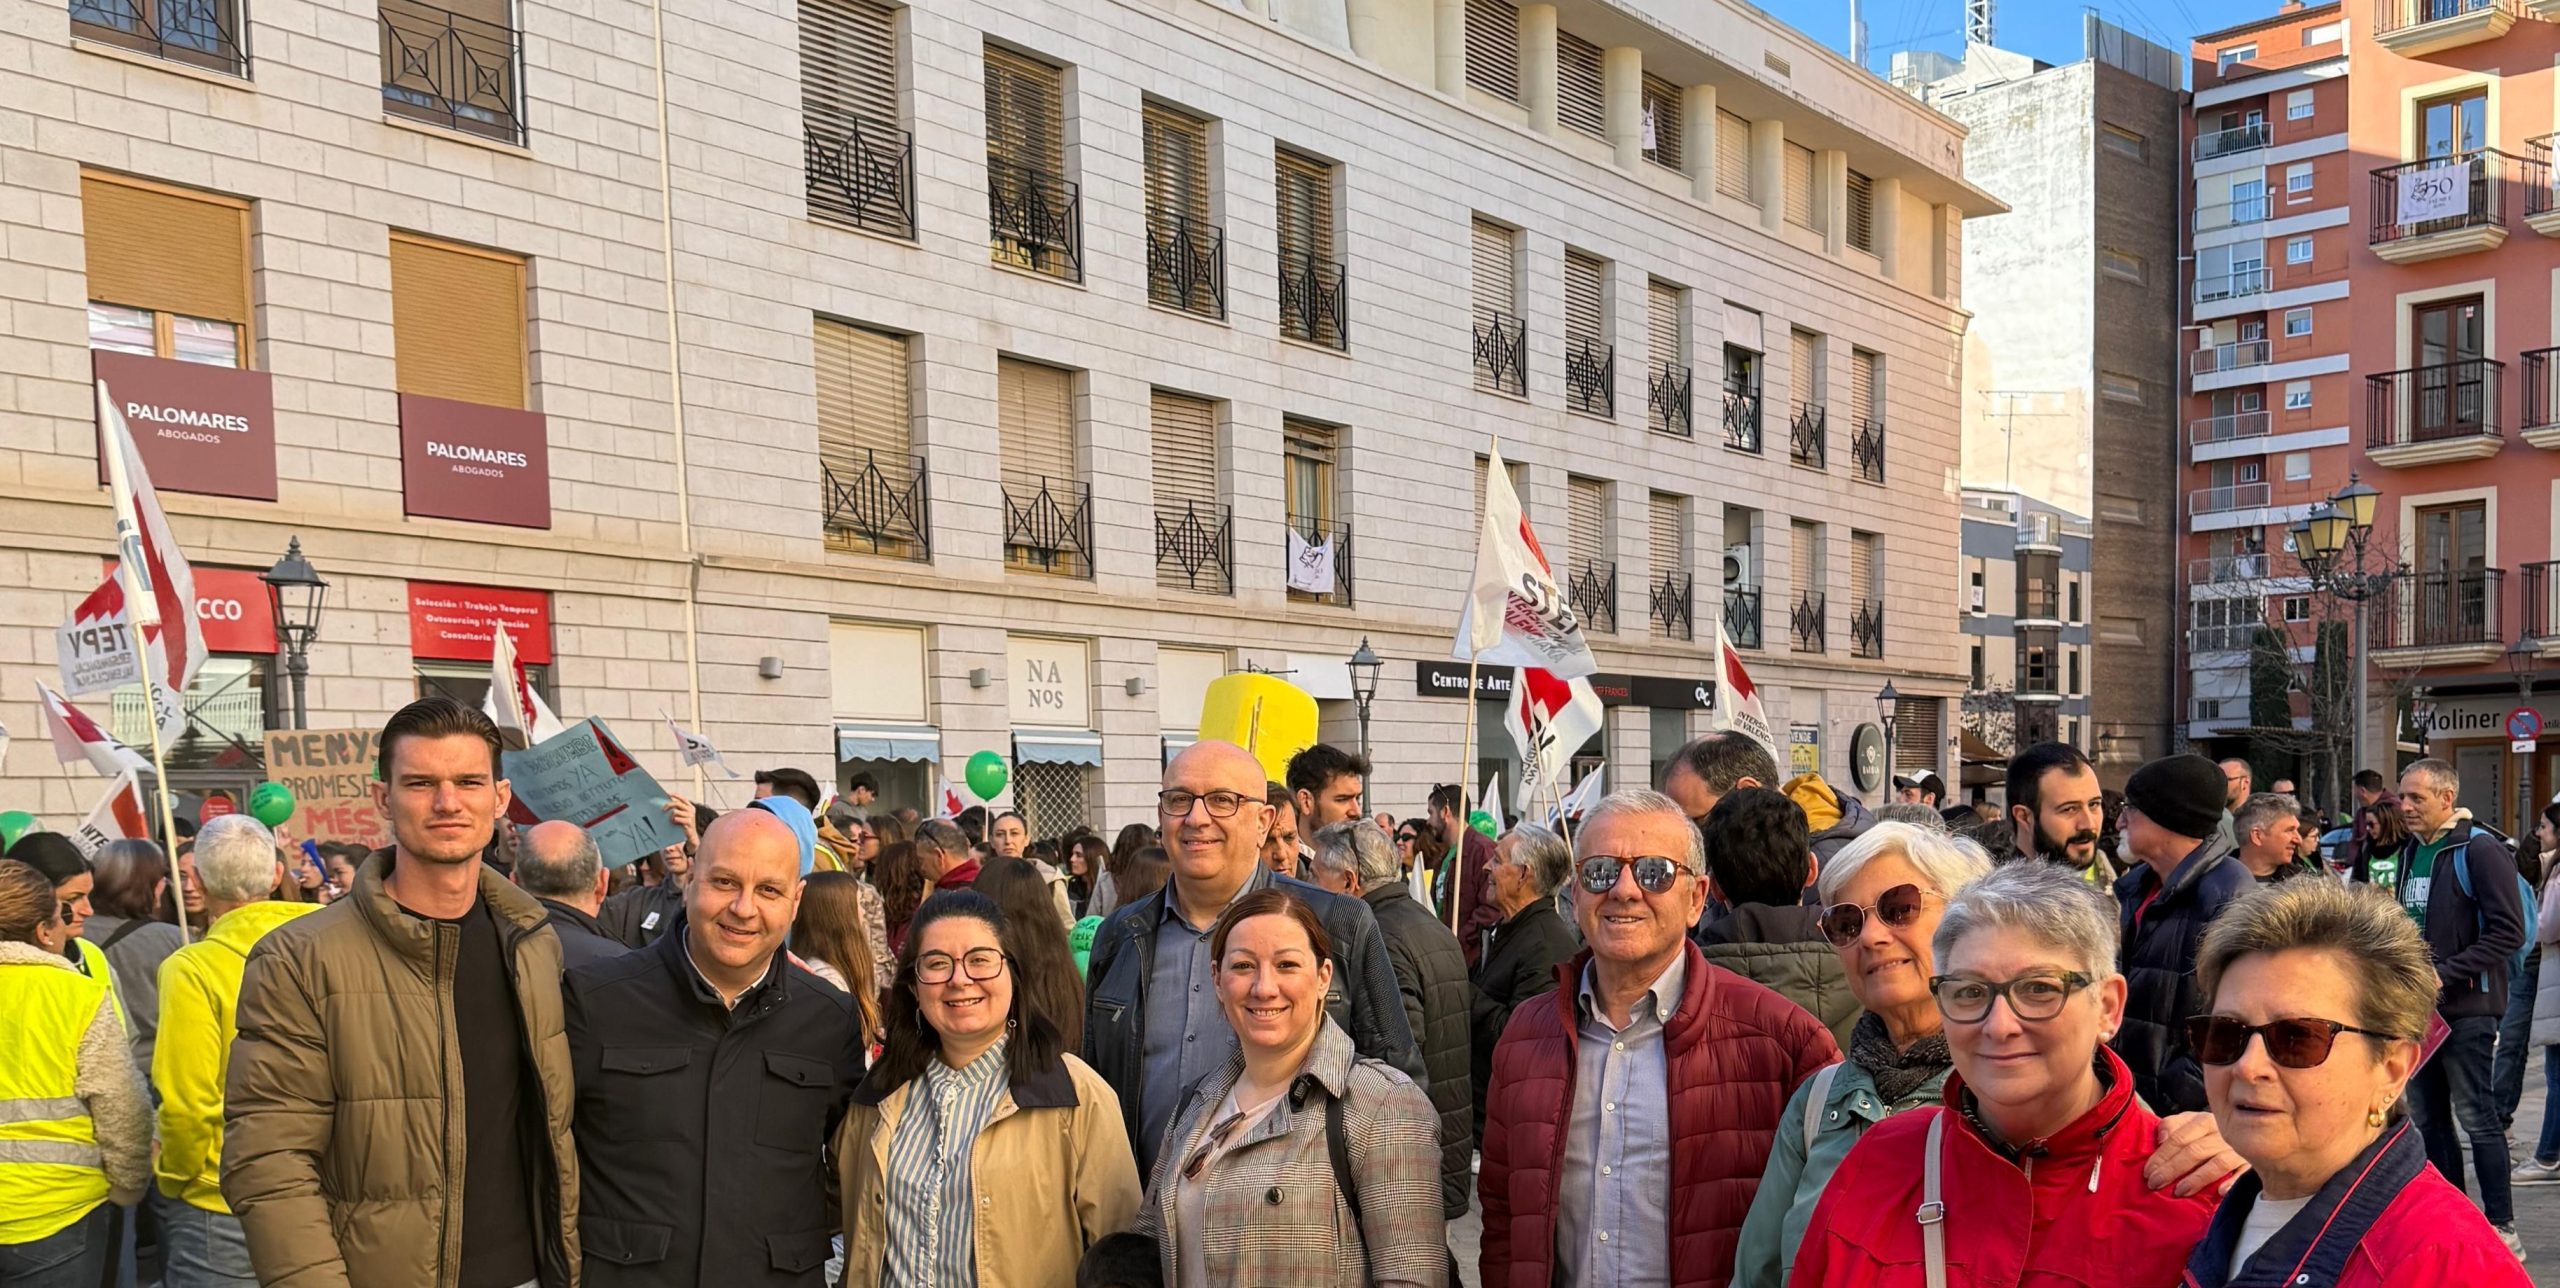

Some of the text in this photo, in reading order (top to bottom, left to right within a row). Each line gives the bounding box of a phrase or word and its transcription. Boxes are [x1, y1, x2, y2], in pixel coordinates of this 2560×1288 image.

[127, 402, 249, 432] PALOMARES
[157, 428, 221, 444] ABOGADOS
[427, 441, 527, 467] PALOMARES
[452, 465, 504, 478] ABOGADOS
[499, 604, 538, 614] Temporal
[486, 618, 530, 629] Fomación
[1027, 659, 1062, 683] NA
[1028, 688, 1063, 709] NOS
